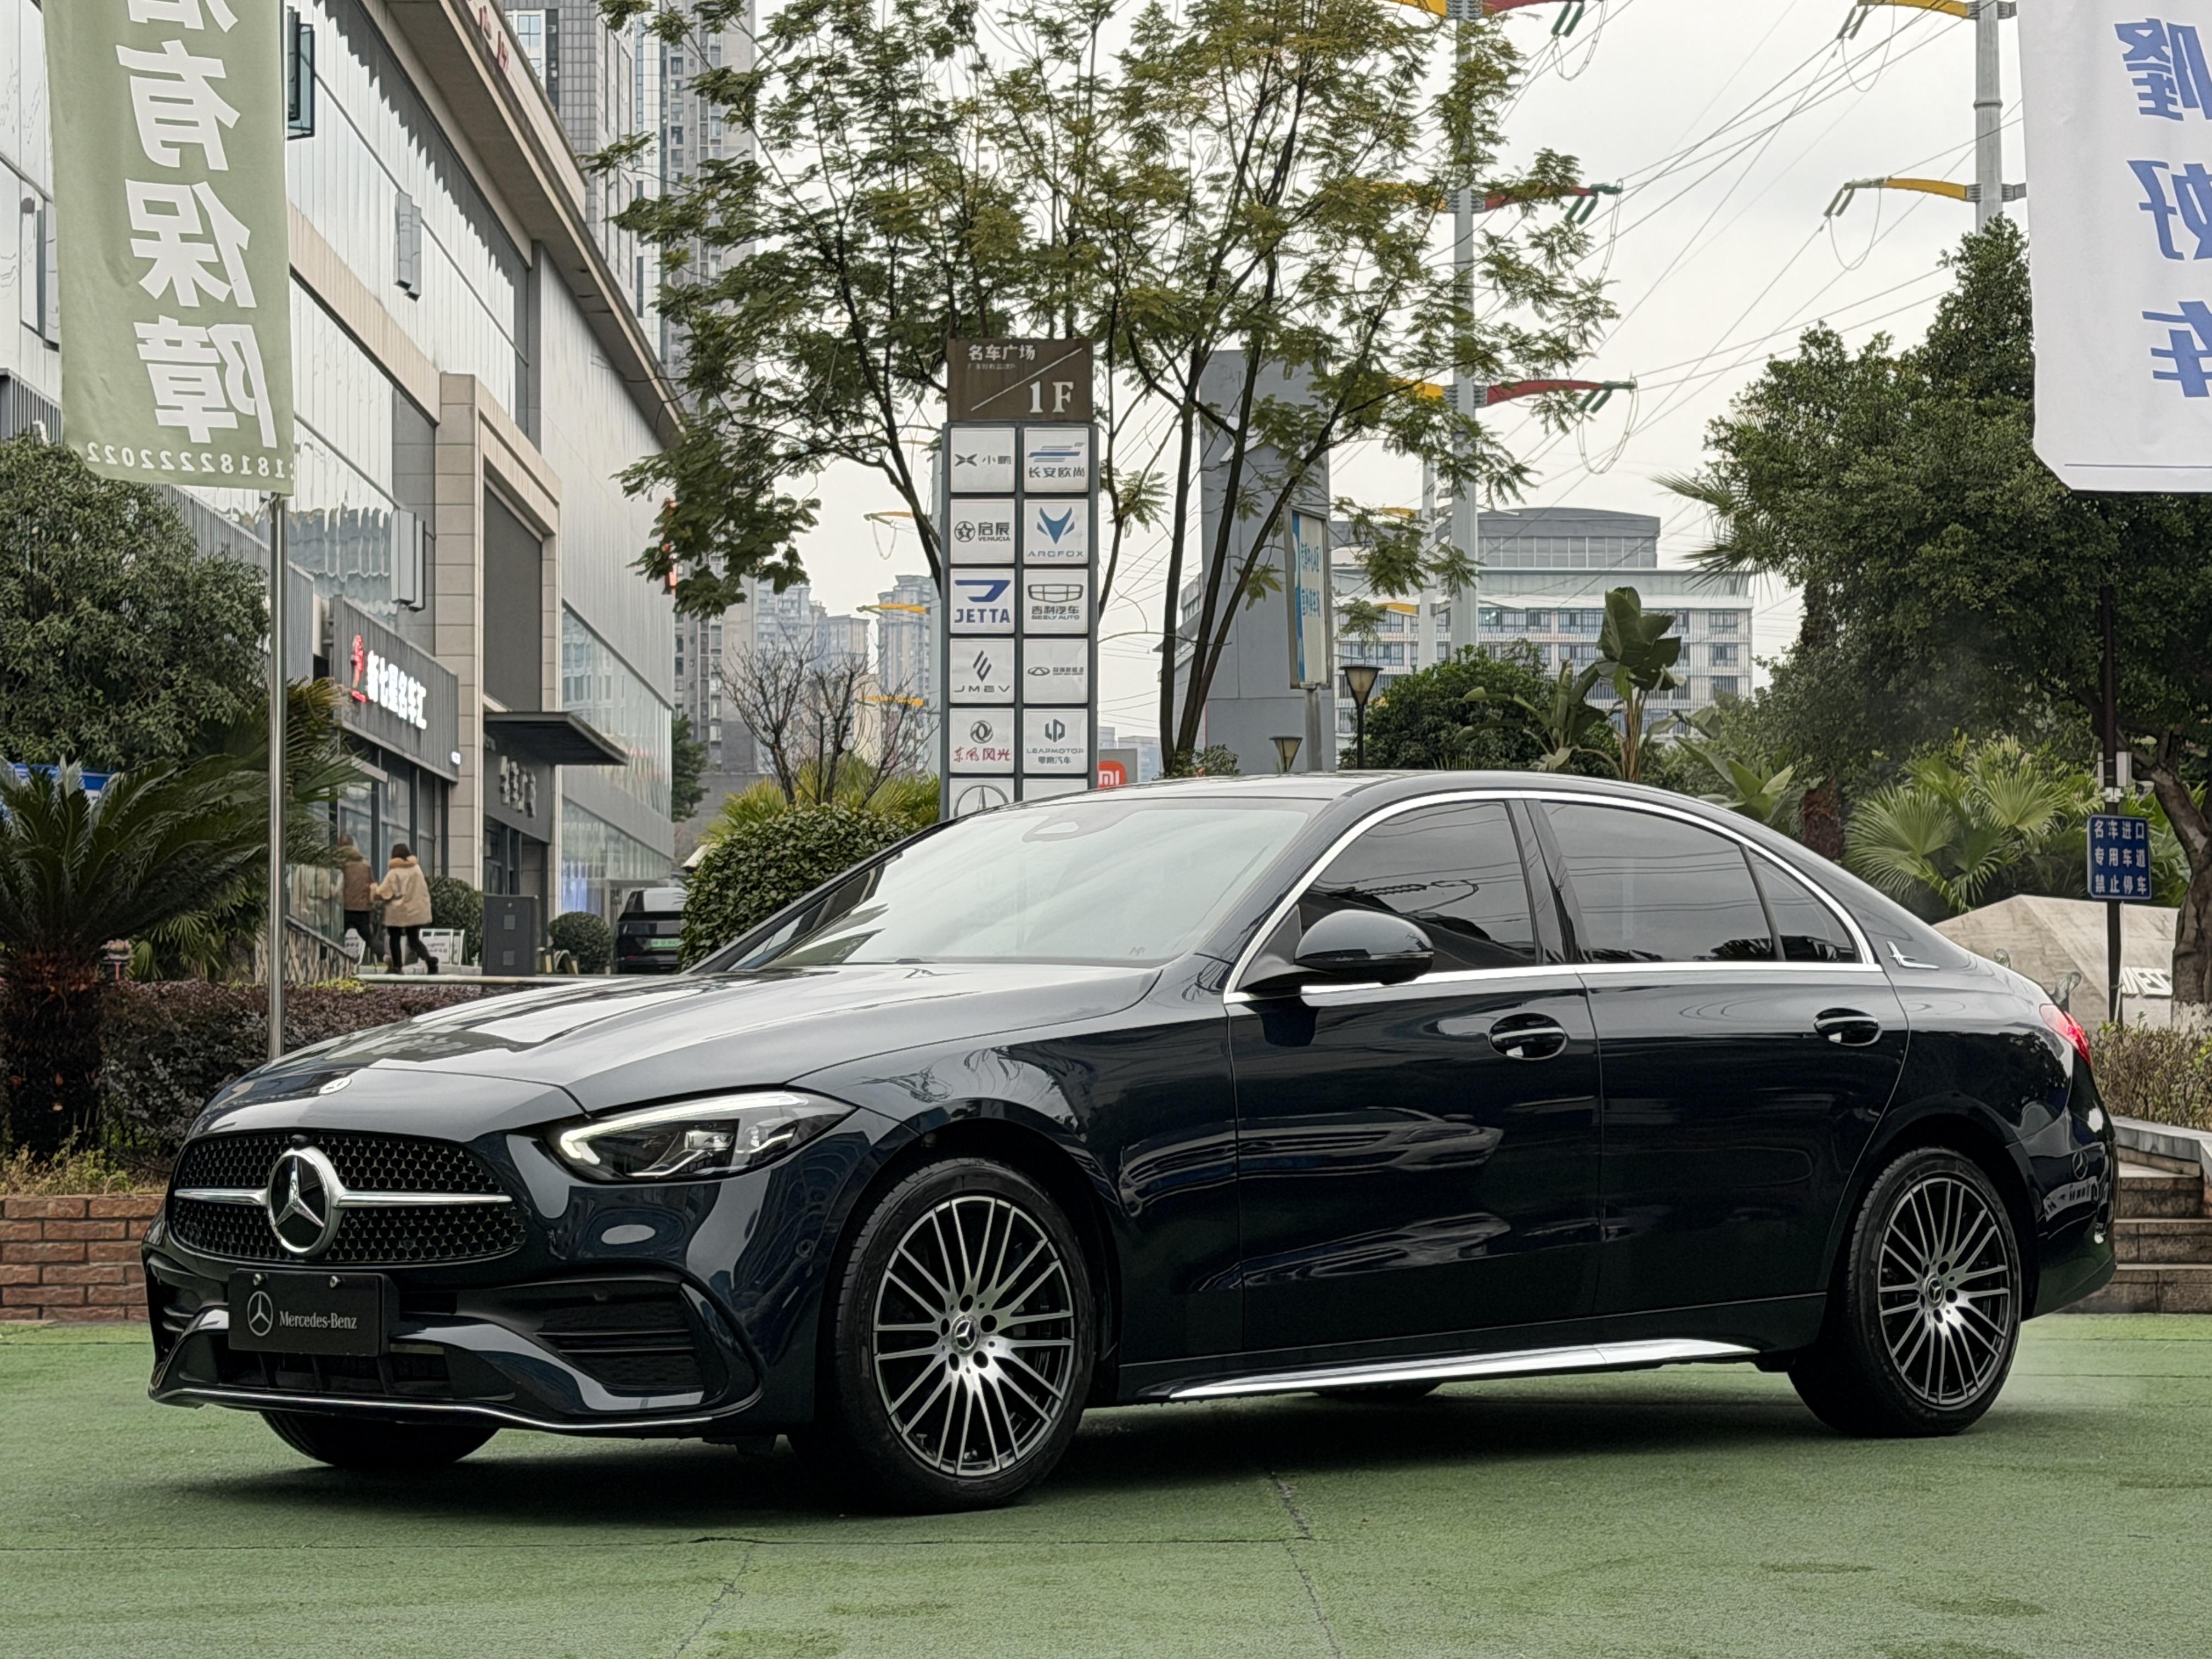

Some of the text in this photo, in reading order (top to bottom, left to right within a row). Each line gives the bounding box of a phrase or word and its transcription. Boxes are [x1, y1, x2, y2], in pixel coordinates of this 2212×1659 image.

[968, 343, 1036, 361] 名车广场
[1029, 381, 1074, 413] 1F
[1028, 466, 1085, 478] 长安欧尚
[978, 521, 1010, 536] 启辰
[954, 608, 1011, 623] JETTA
[954, 685, 1011, 693] JMEV
[2095, 845, 2146, 868] 专用车道
[2095, 873, 2147, 895] 禁止停车
[279, 1310, 358, 1329] Mercedes-Benz
